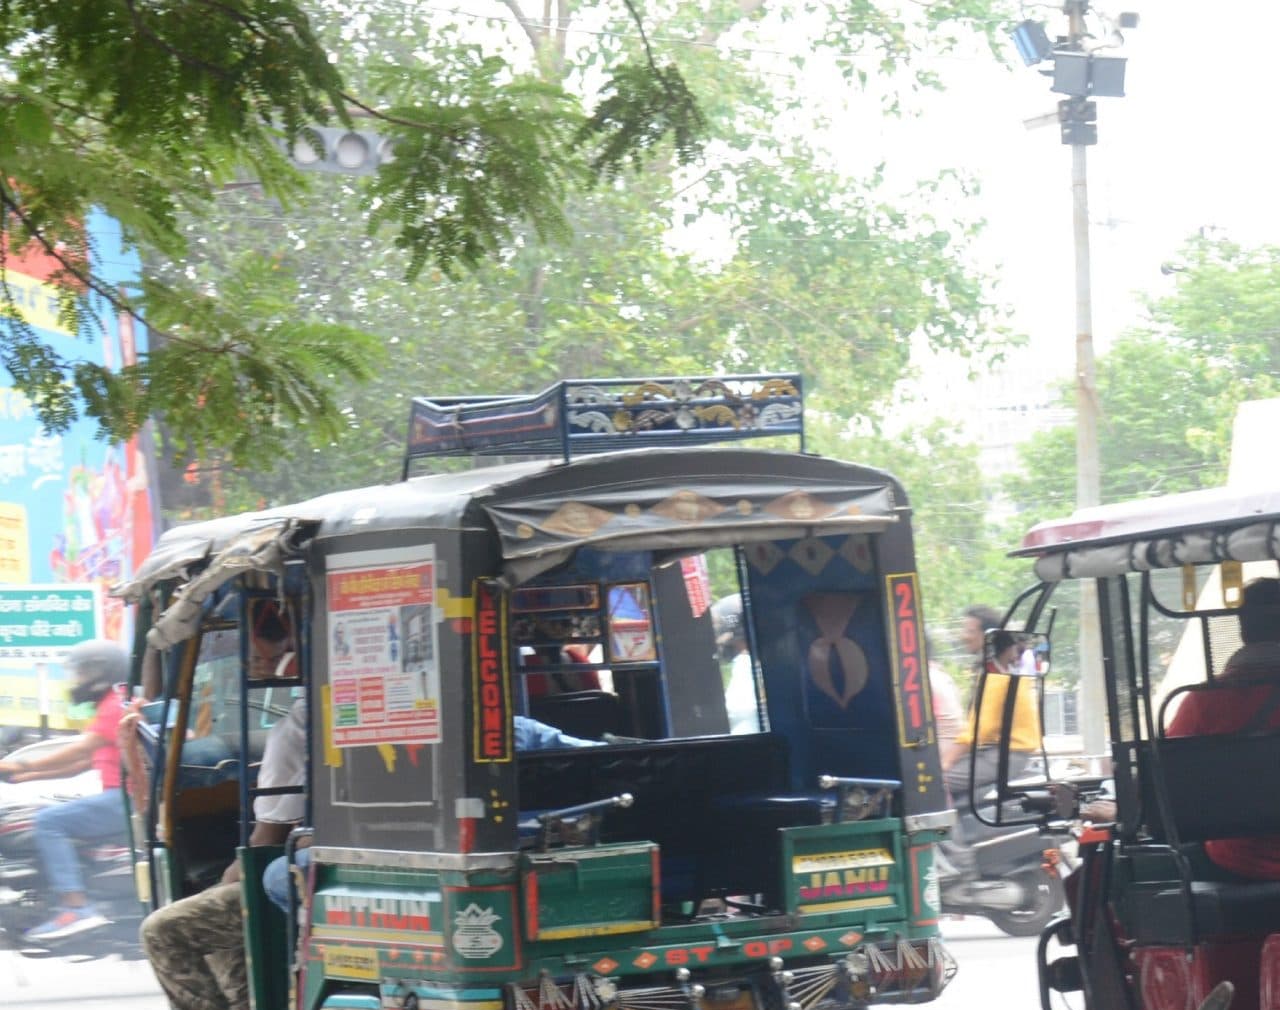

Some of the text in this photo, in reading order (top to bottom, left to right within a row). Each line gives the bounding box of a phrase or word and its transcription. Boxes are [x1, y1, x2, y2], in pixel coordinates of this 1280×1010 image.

[896, 583, 922, 728] 2021
[800, 866, 889, 899] JANU
[325, 895, 431, 931] MITHUN
